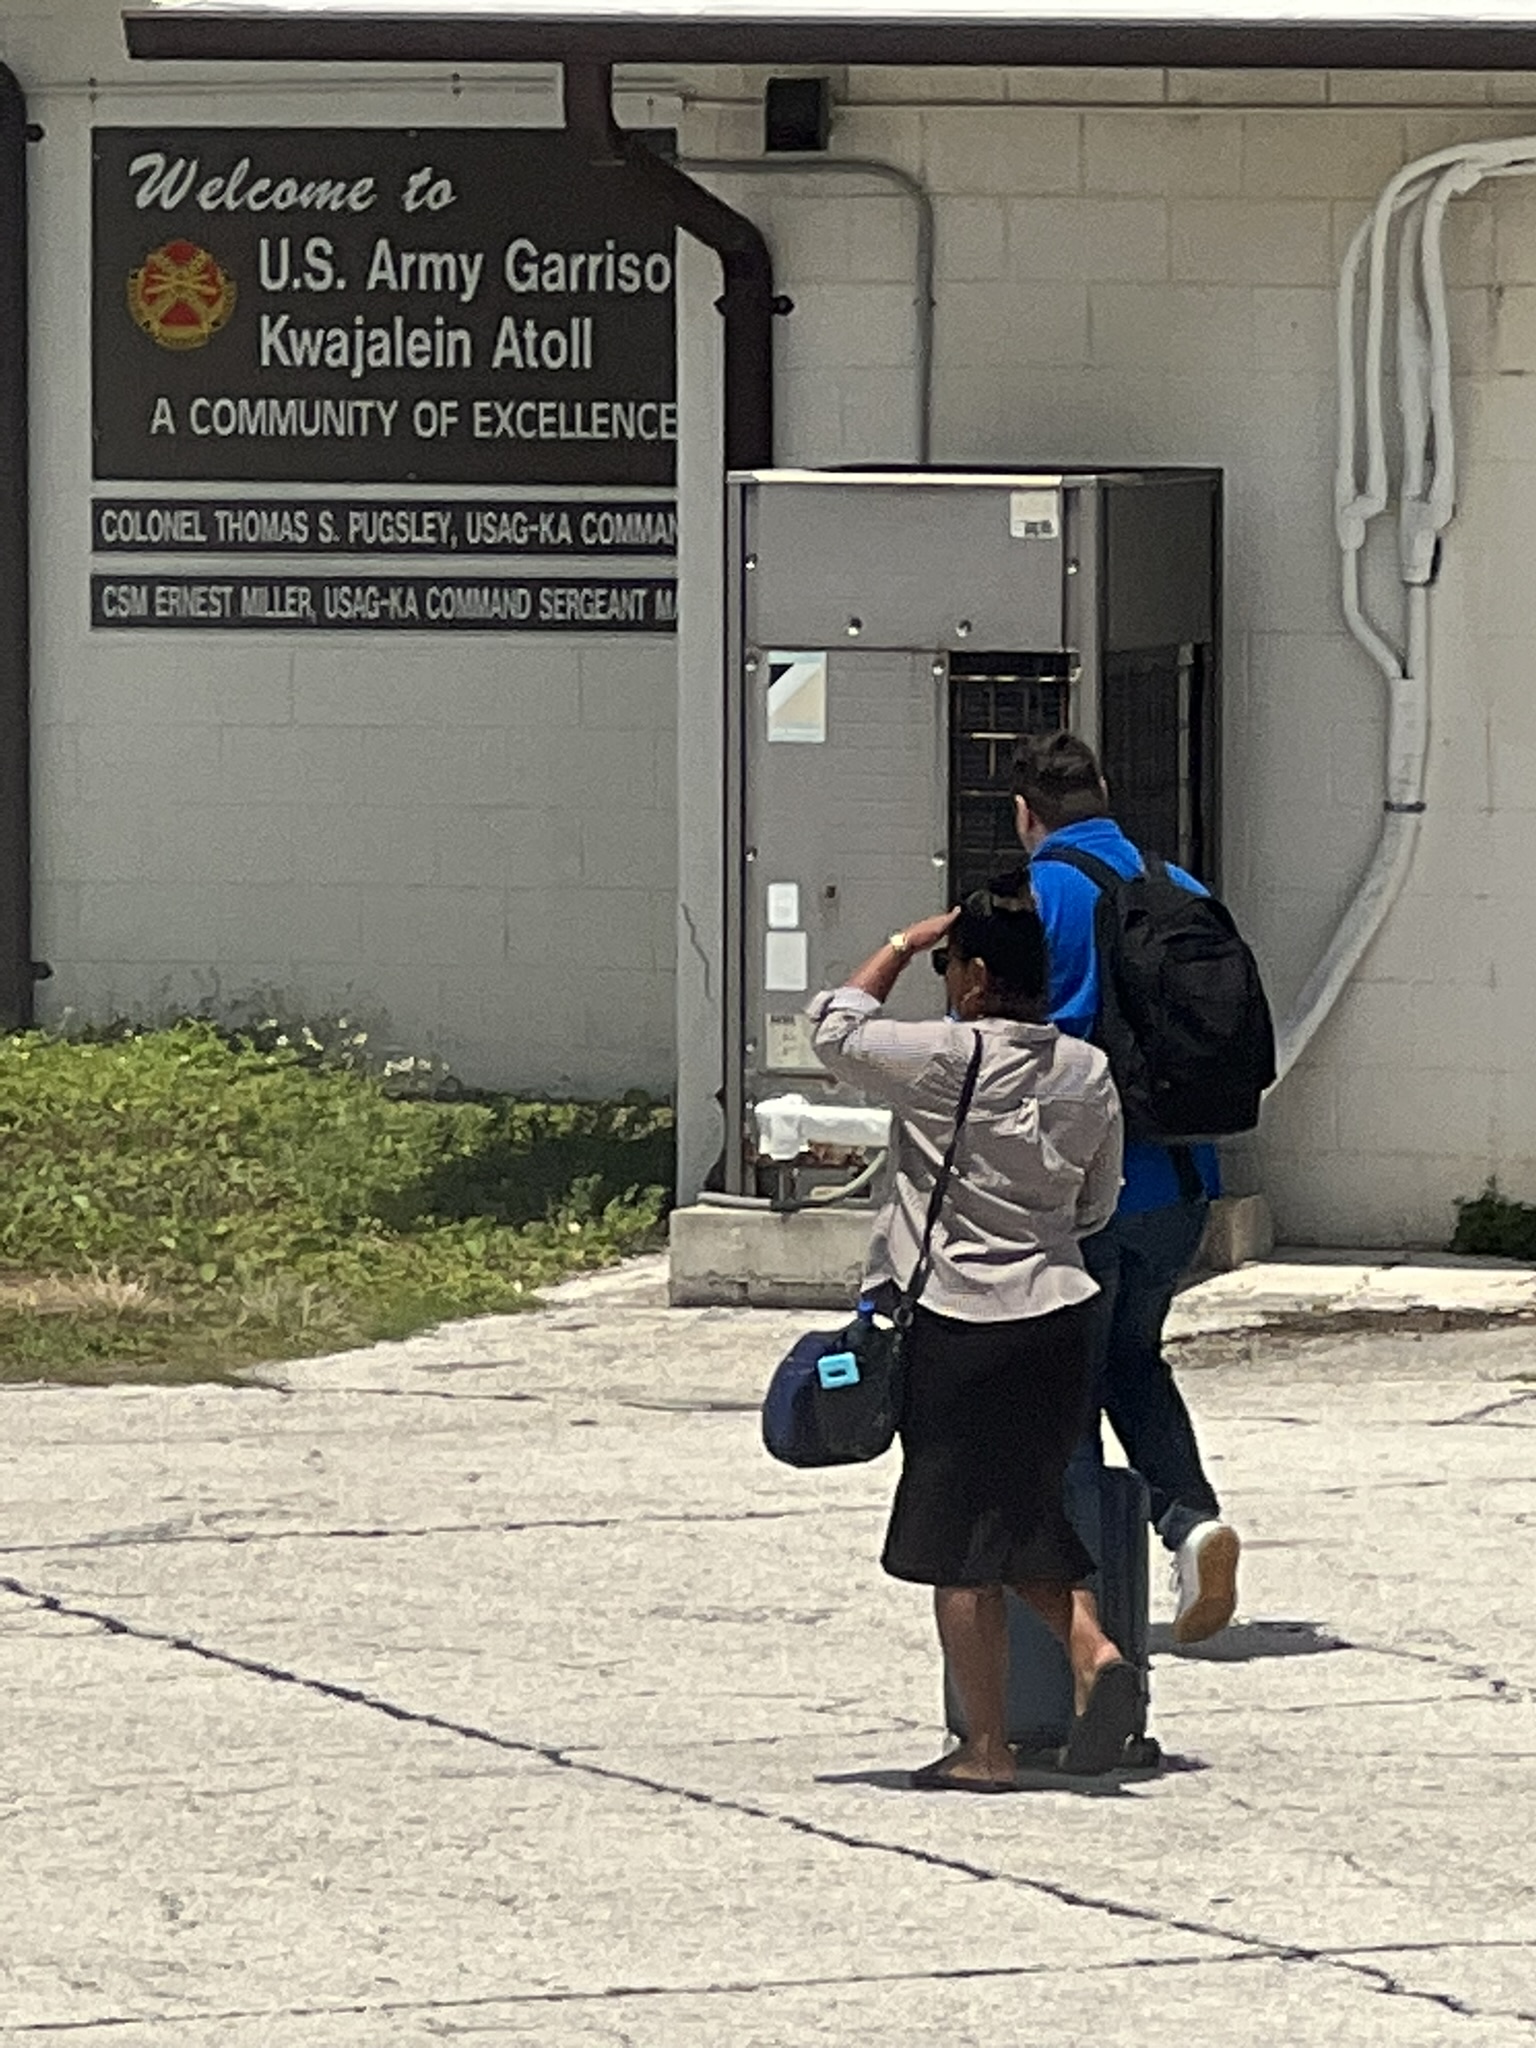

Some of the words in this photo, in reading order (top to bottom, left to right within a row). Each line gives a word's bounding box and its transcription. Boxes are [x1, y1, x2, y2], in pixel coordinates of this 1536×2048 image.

[128, 152, 377, 211] Welcome
[401, 166, 457, 212] to
[259, 237, 346, 291] U.S.
[366, 237, 484, 302] Army
[504, 237, 672, 293] Garriso
[260, 314, 471, 378] Kwajalein
[491, 315, 592, 369] Atoll
[151, 398, 176, 434] A
[190, 398, 399, 437] COMMUNITY
[413, 401, 459, 438] OF
[473, 401, 677, 440] EXCELLENCE
[101, 509, 207, 542] COLONEL
[214, 510, 309, 543] THOMAS
[318, 511, 340, 543] S.
[349, 511, 458, 549] PUGSLEY,
[466, 511, 573, 544] USAG-KA
[102, 585, 148, 617] CSM
[155, 585, 233, 617] ERNEST
[241, 586, 317, 623] MILLER,
[324, 586, 419, 619] USAG-KA
[425, 587, 532, 620] COMMAND
[539, 588, 647, 620] SERGEANT
[655, 588, 677, 620] M
